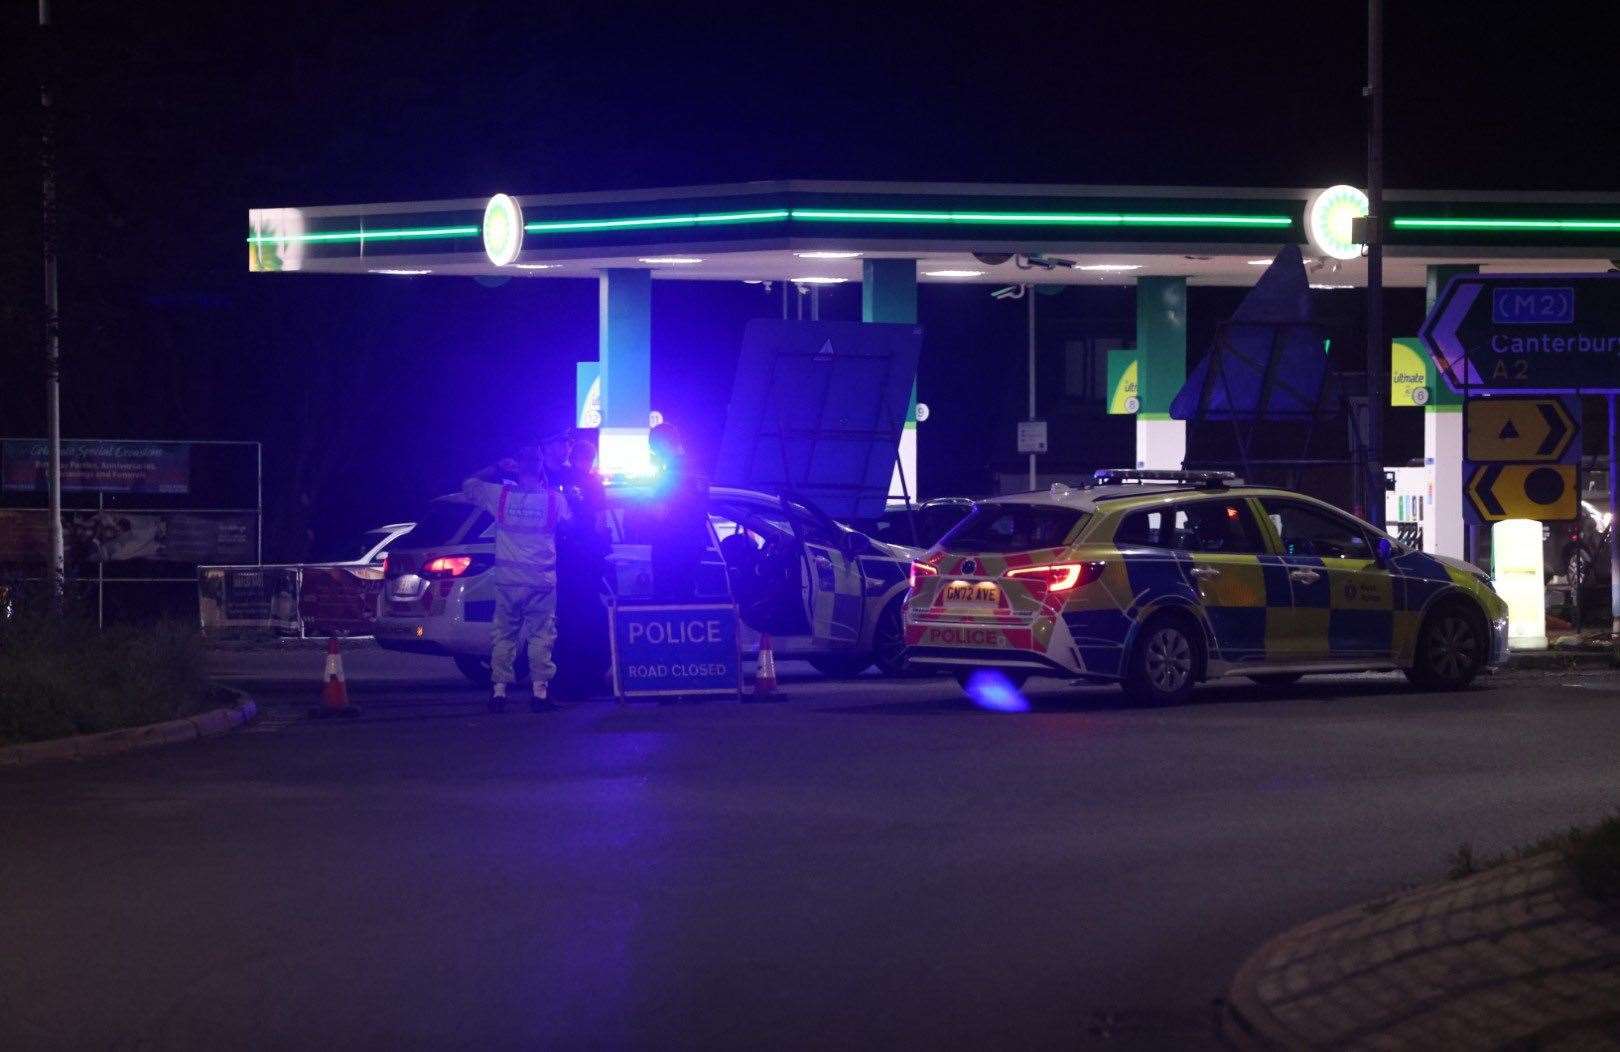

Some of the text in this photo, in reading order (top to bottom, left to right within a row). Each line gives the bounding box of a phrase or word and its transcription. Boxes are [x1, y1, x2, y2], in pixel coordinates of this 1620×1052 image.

[1499, 293, 1569, 319] (M2)
[1493, 358, 1529, 381] A2
[628, 620, 722, 644] POLICE
[930, 629, 998, 645] POLICE
[628, 663, 726, 678] ROAD CLOSED
